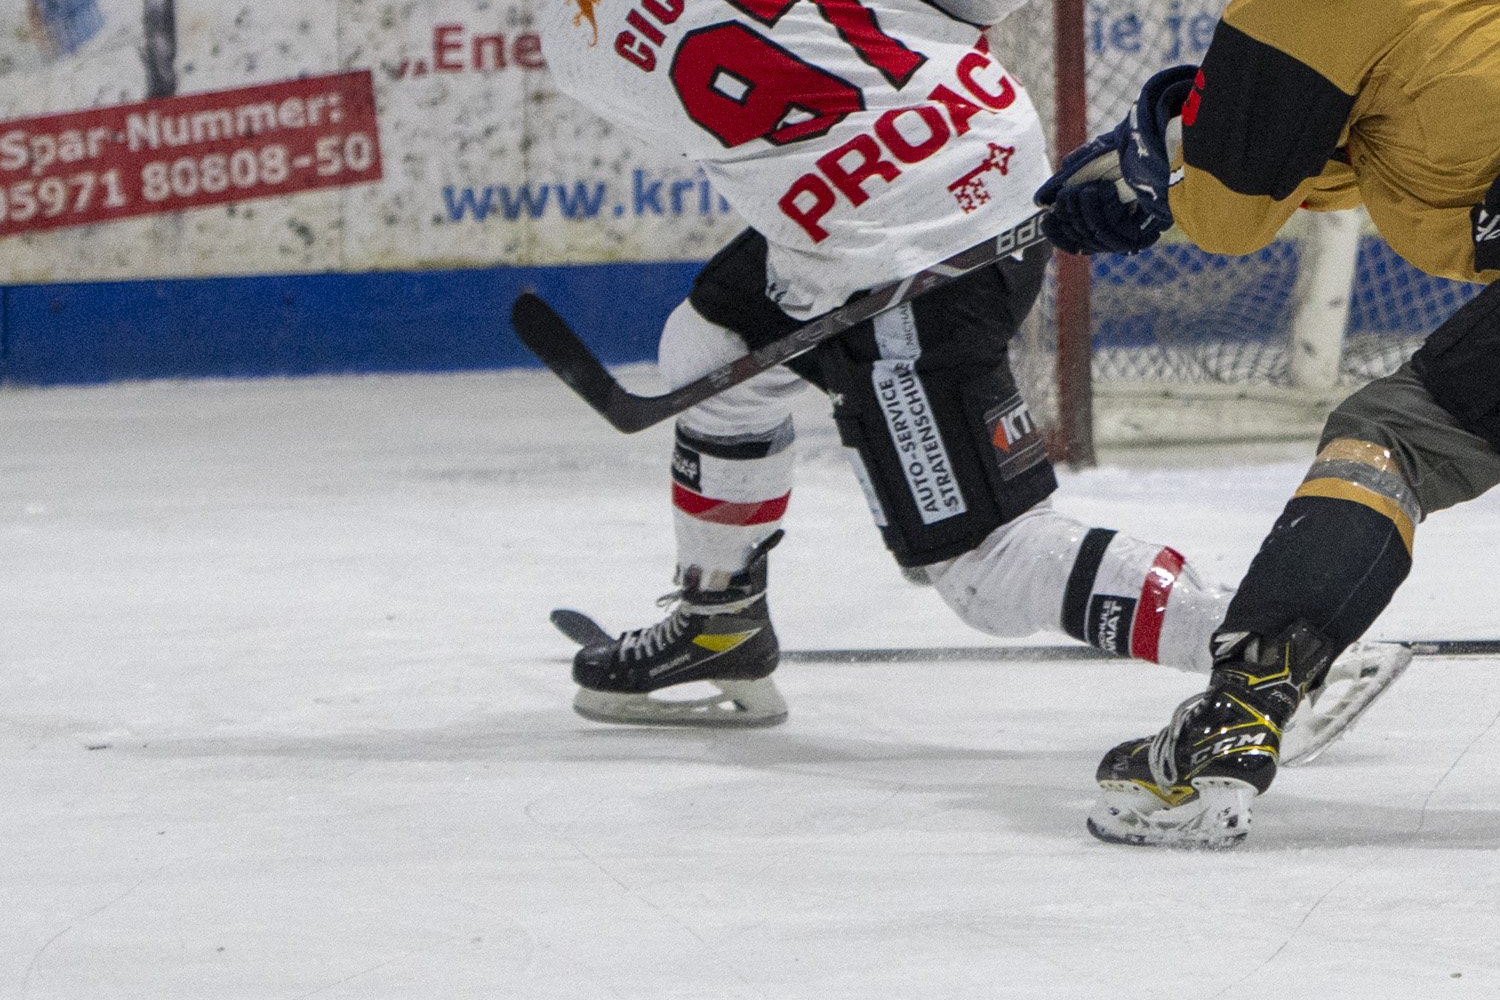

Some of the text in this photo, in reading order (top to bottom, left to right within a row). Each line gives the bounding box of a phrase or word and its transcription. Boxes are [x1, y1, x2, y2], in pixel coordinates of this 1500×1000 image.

[0, 92, 345, 176] Spar-Nummer:
[141, 131, 373, 201] 80808-50
[777, 52, 1024, 245] PROAC
[442, 168, 731, 222] www.kri
[879, 378, 939, 513] AUTO-SERVICE
[893, 362, 960, 508] STRATENSCHULE
